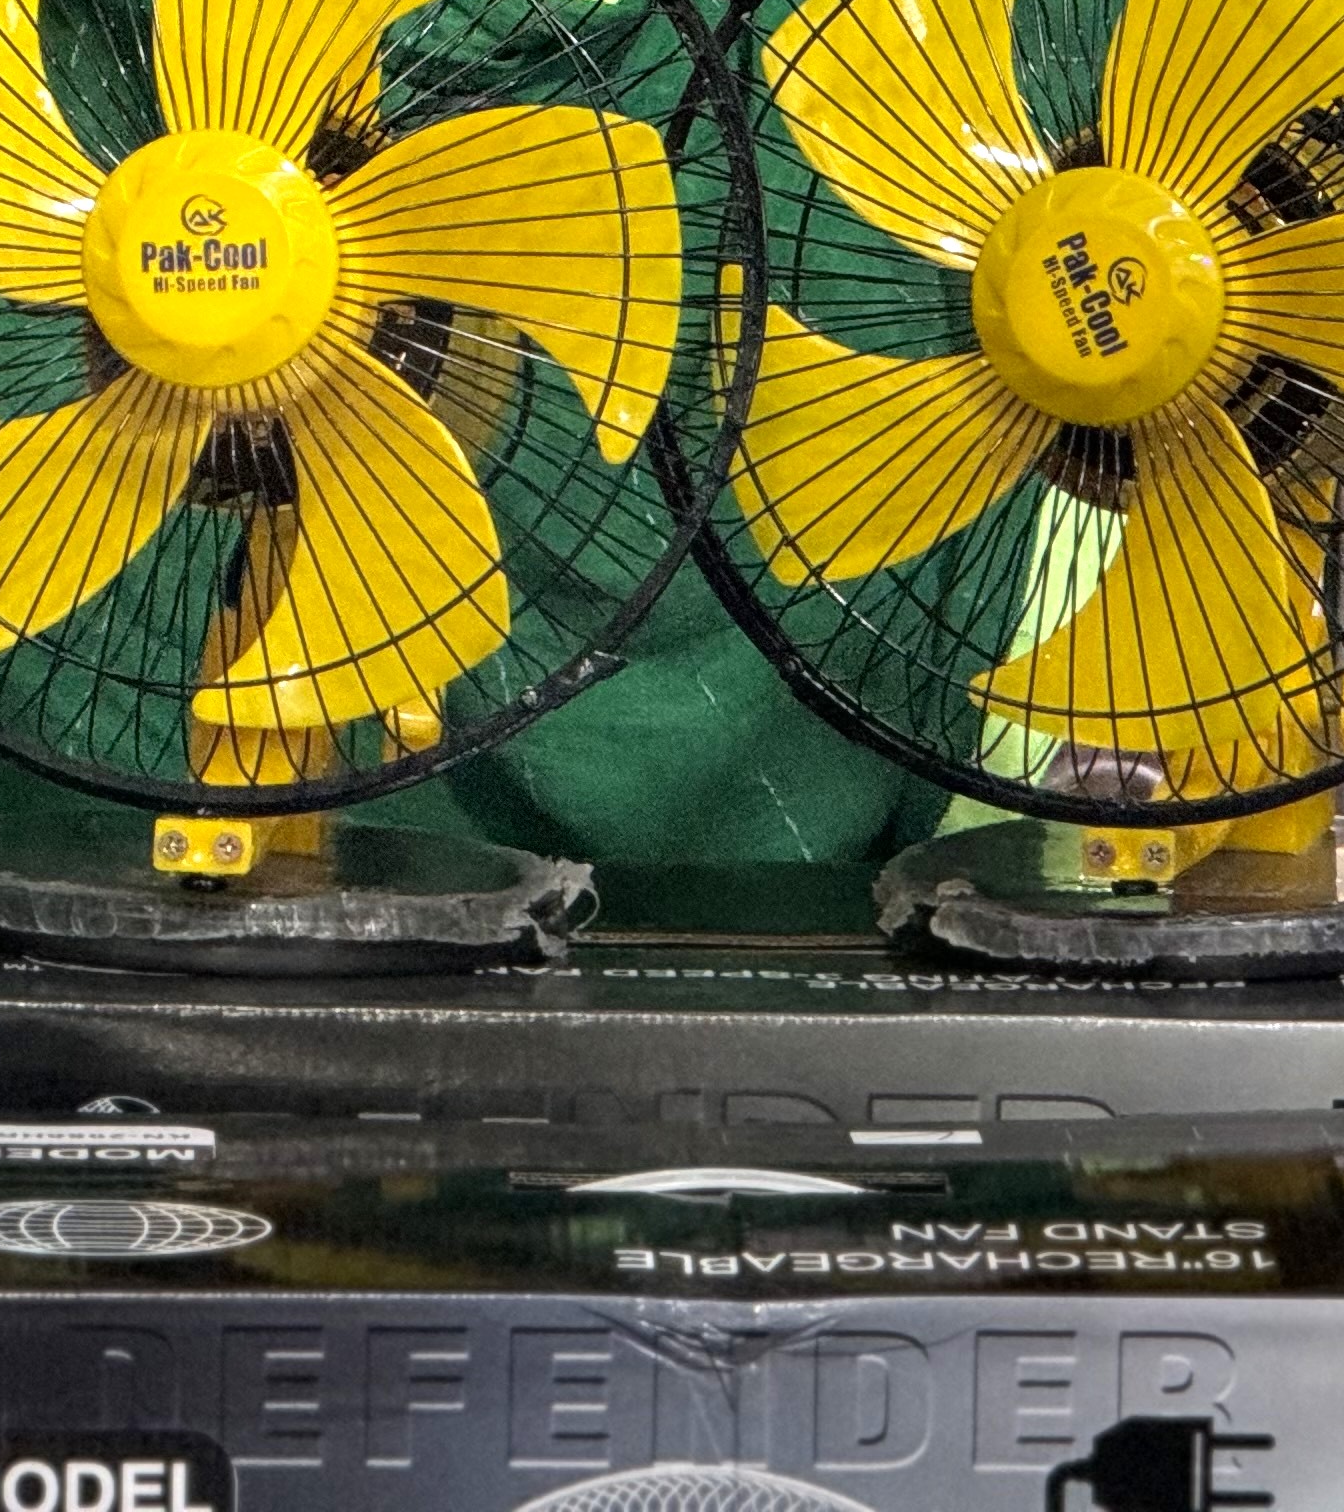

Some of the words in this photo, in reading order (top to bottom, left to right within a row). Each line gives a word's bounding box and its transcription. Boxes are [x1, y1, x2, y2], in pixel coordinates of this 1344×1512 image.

[141, 238, 268, 273] Pak-Cool
[153, 274, 227, 293] Hi-Speed
[232, 274, 260, 290] Fan
[1057, 231, 1129, 357] Pak-Cool
[1072, 324, 1093, 358] Fan
[892, 1221, 1019, 1240] FAN
[1043, 1221, 1267, 1240] STAND
[64, 1325, 1243, 1473] DEFENDER
